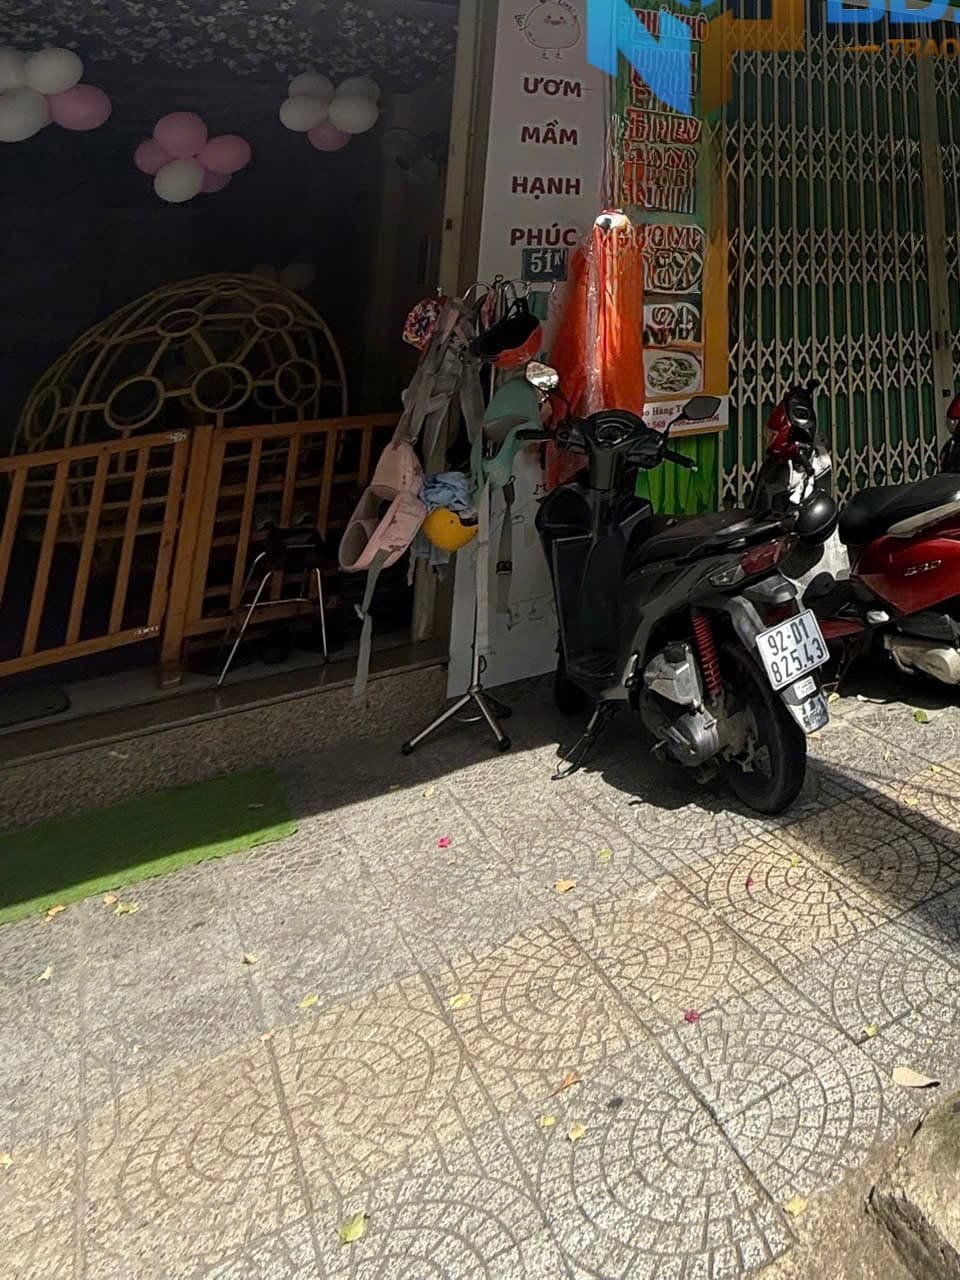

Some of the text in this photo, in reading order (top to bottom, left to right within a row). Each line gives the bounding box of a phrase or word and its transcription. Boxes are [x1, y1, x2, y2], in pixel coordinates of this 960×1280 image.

[523, 77, 582, 97] ƯƠM
[520, 119, 578, 146] MẦM
[511, 176, 581, 200] HẠNH
[510, 223, 577, 247] PHÚC
[770, 637, 824, 683] 825.43
